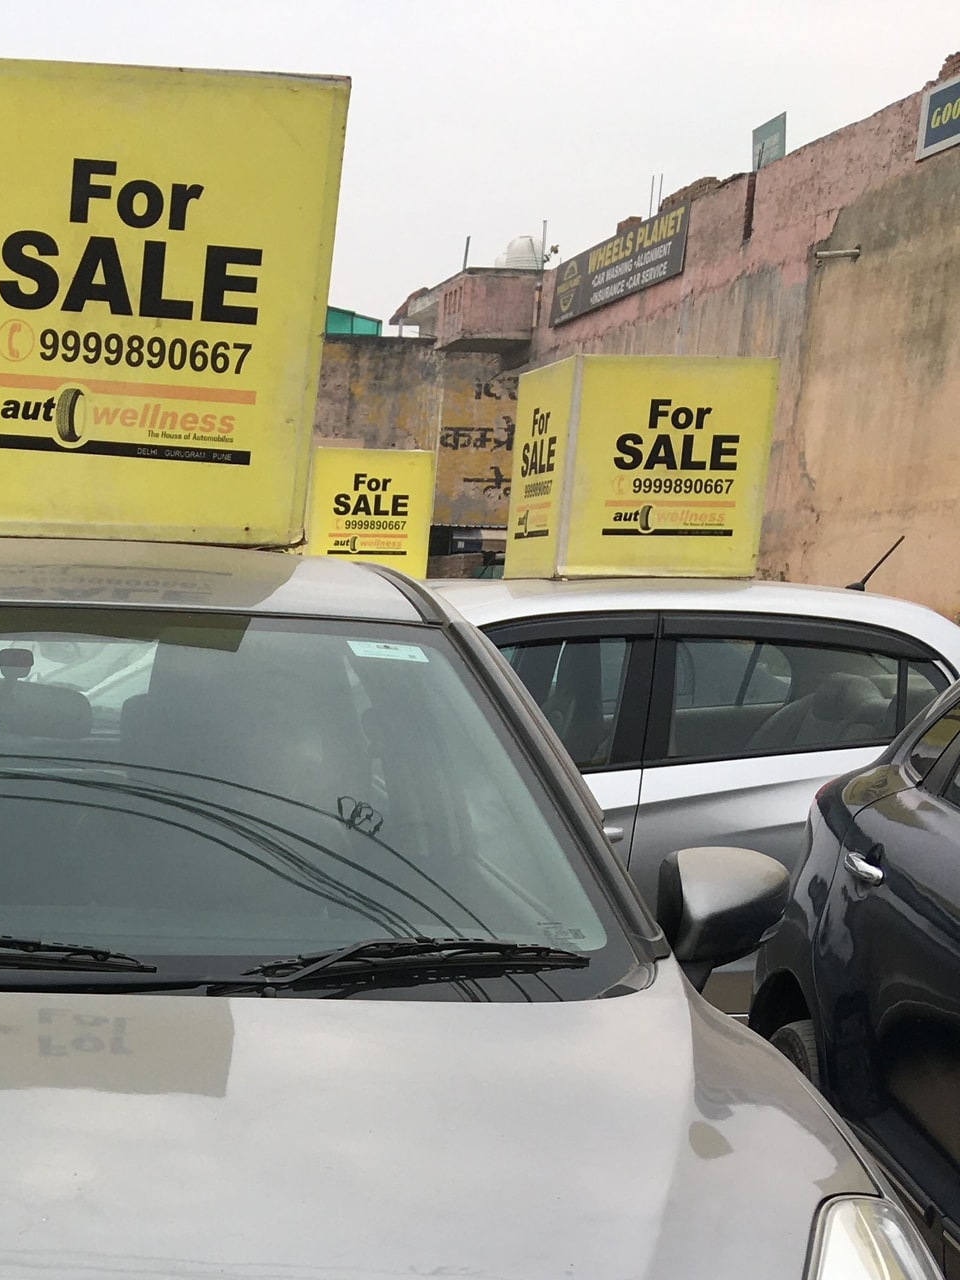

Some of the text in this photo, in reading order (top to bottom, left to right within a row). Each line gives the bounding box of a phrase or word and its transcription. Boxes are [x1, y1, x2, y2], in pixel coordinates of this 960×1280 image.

[69, 158, 204, 231] For
[588, 206, 685, 274] WHEELS PLANET
[39, 328, 252, 375] 9999890667
[93, 402, 236, 435] wellness
[532, 407, 551, 437] For
[648, 398, 713, 430] For
[521, 436, 557, 478] SALE
[613, 433, 740, 471] SALE
[353, 473, 392, 492] For
[632, 478, 734, 495] 9999890667
[333, 493, 409, 516] SALE
[345, 520, 406, 530] 9999890667
